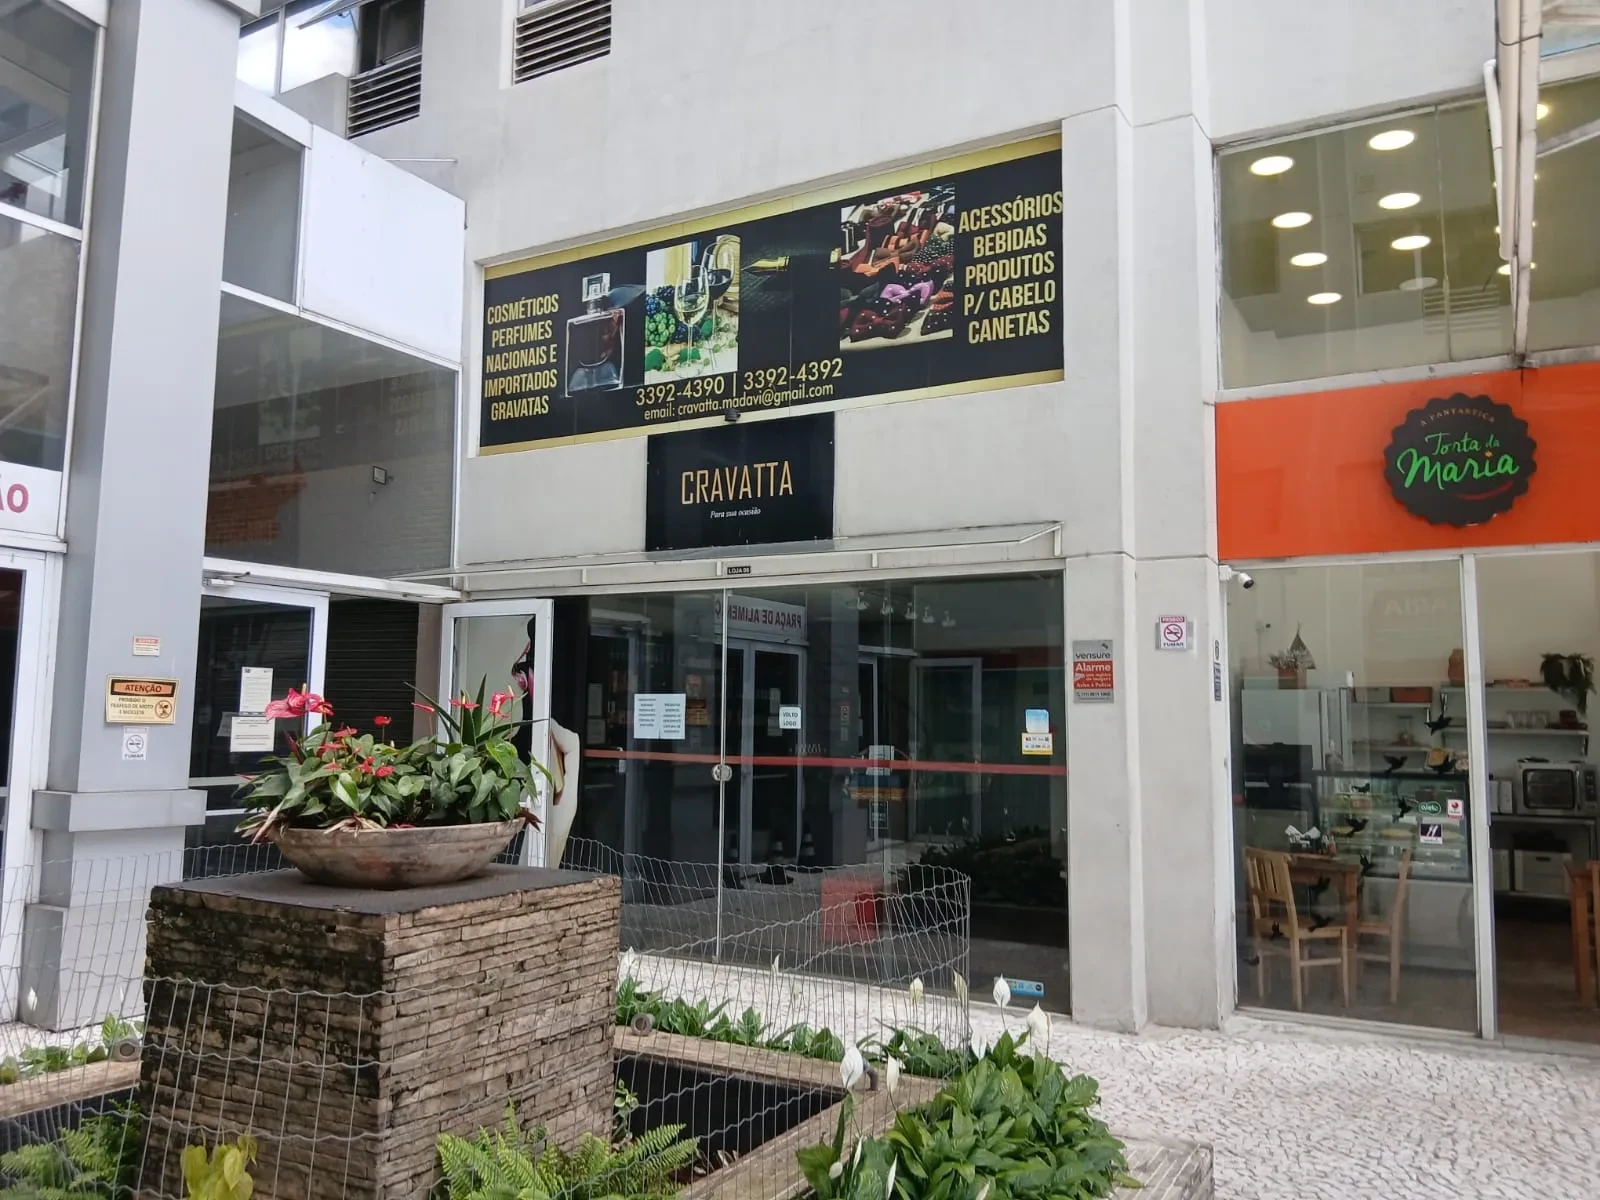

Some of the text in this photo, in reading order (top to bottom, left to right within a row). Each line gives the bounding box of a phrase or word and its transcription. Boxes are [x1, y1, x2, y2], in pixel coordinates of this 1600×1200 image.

[958, 190, 1063, 234] ACESSÓRIOS
[973, 223, 1047, 258] BEBIDAS
[965, 251, 1055, 288] PRODUTOS
[487, 294, 559, 326] COSMÉTICOS
[963, 279, 1056, 316] P/ CABELO
[492, 320, 552, 348] PERFUMES
[968, 309, 1050, 344] CANETAS
[486, 344, 557, 374] NACIONAIS E
[484, 370, 557, 398] IMPORTADOS
[636, 375, 725, 406] 3392-4390
[743, 358, 843, 391] 3392-4392
[491, 396, 549, 422] GRAVATAS
[644, 382, 834, 422] email: cravatta.madavi@gmail.com
[1424, 432, 1500, 456] Torta da
[681, 460, 793, 505] CRAVATTA
[1397, 448, 1519, 490] Maria
[0, 473, 29, 513] O
[728, 567, 742, 575] LOJA
[1075, 662, 1111, 672] Alarme
[125, 684, 162, 694] ATENÇÃO
